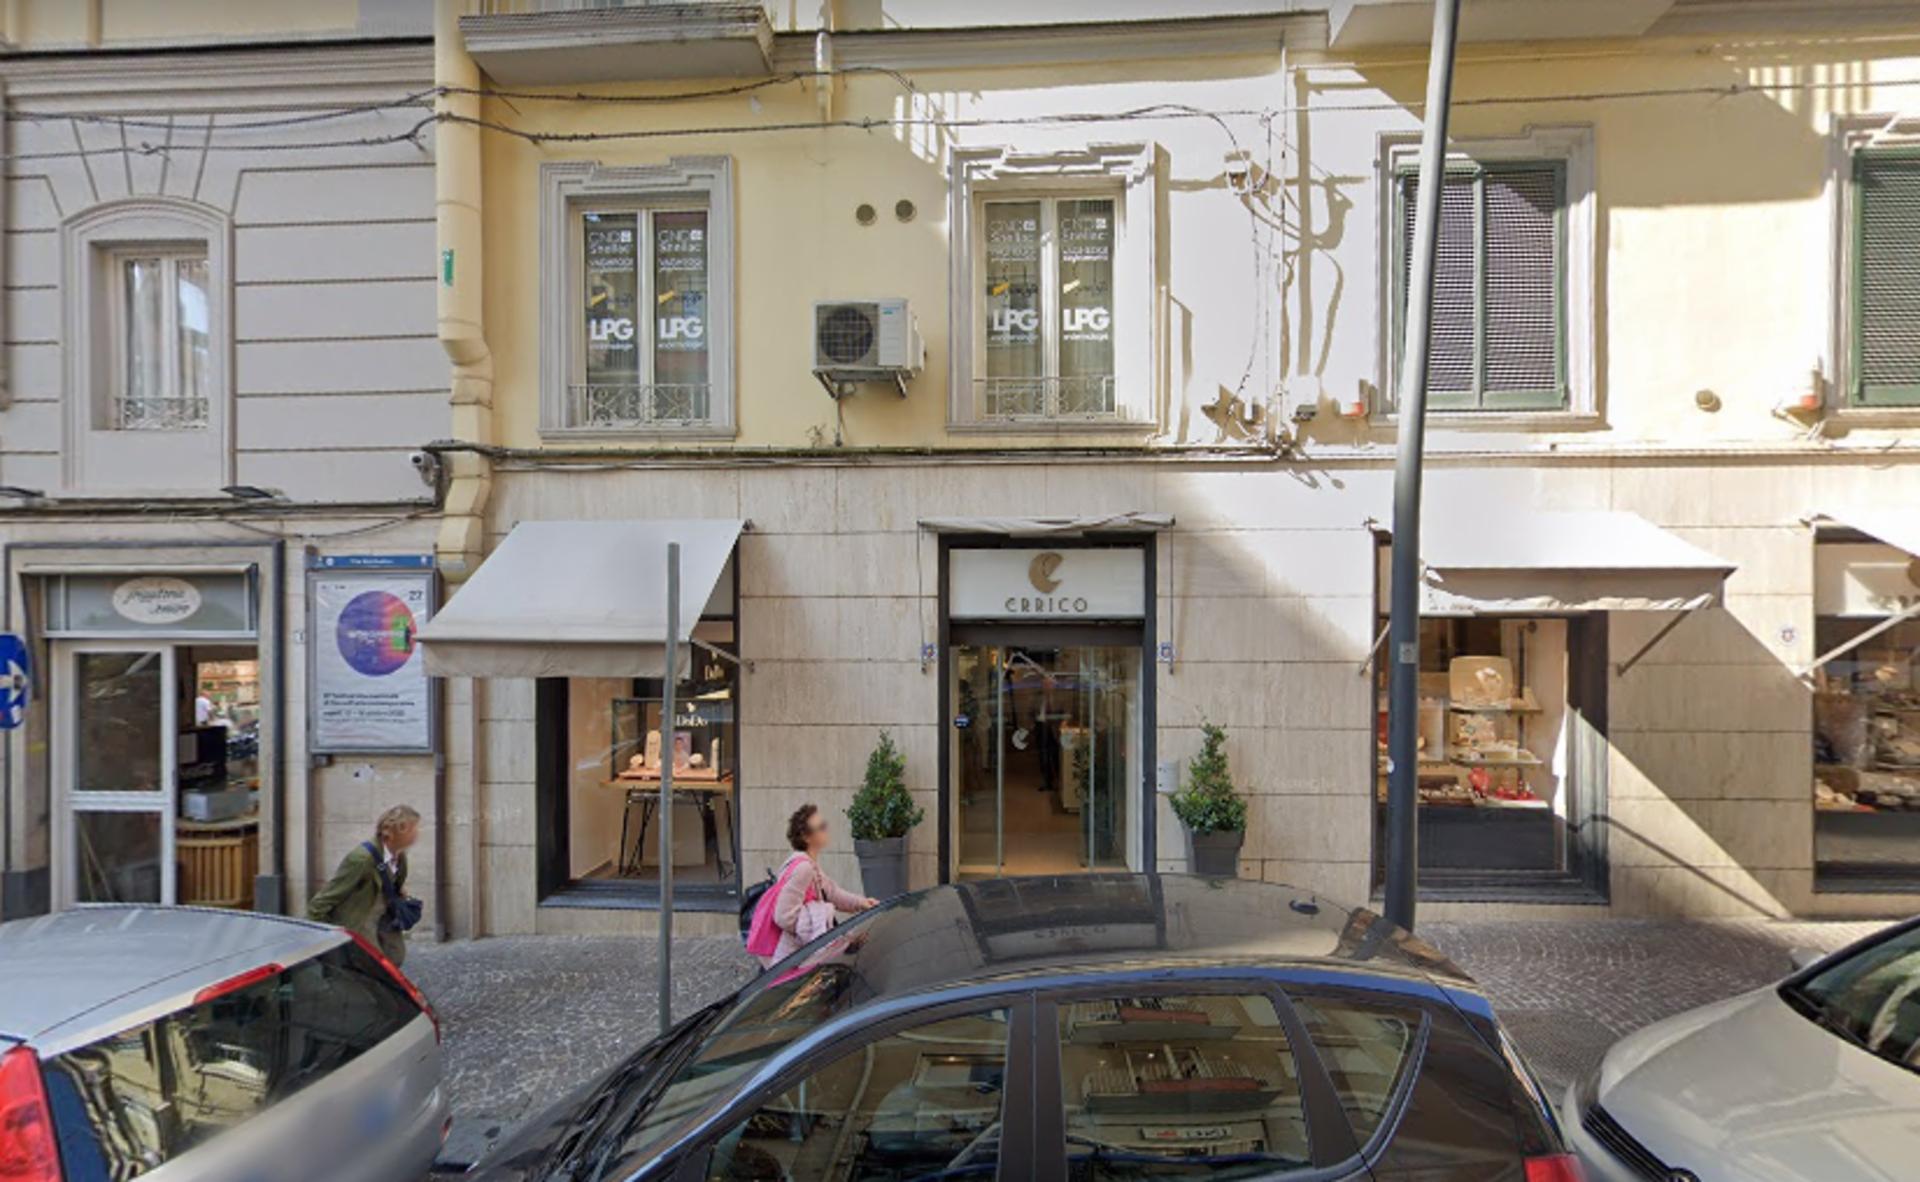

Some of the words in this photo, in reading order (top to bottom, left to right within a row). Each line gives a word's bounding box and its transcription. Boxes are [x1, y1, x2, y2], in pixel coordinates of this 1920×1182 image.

[590, 318, 633, 340] LPG
[660, 317, 703, 339] LPG
[993, 308, 1039, 331] LPG
[1063, 307, 1110, 331] LPG
[1005, 597, 1088, 613] ERRICO
